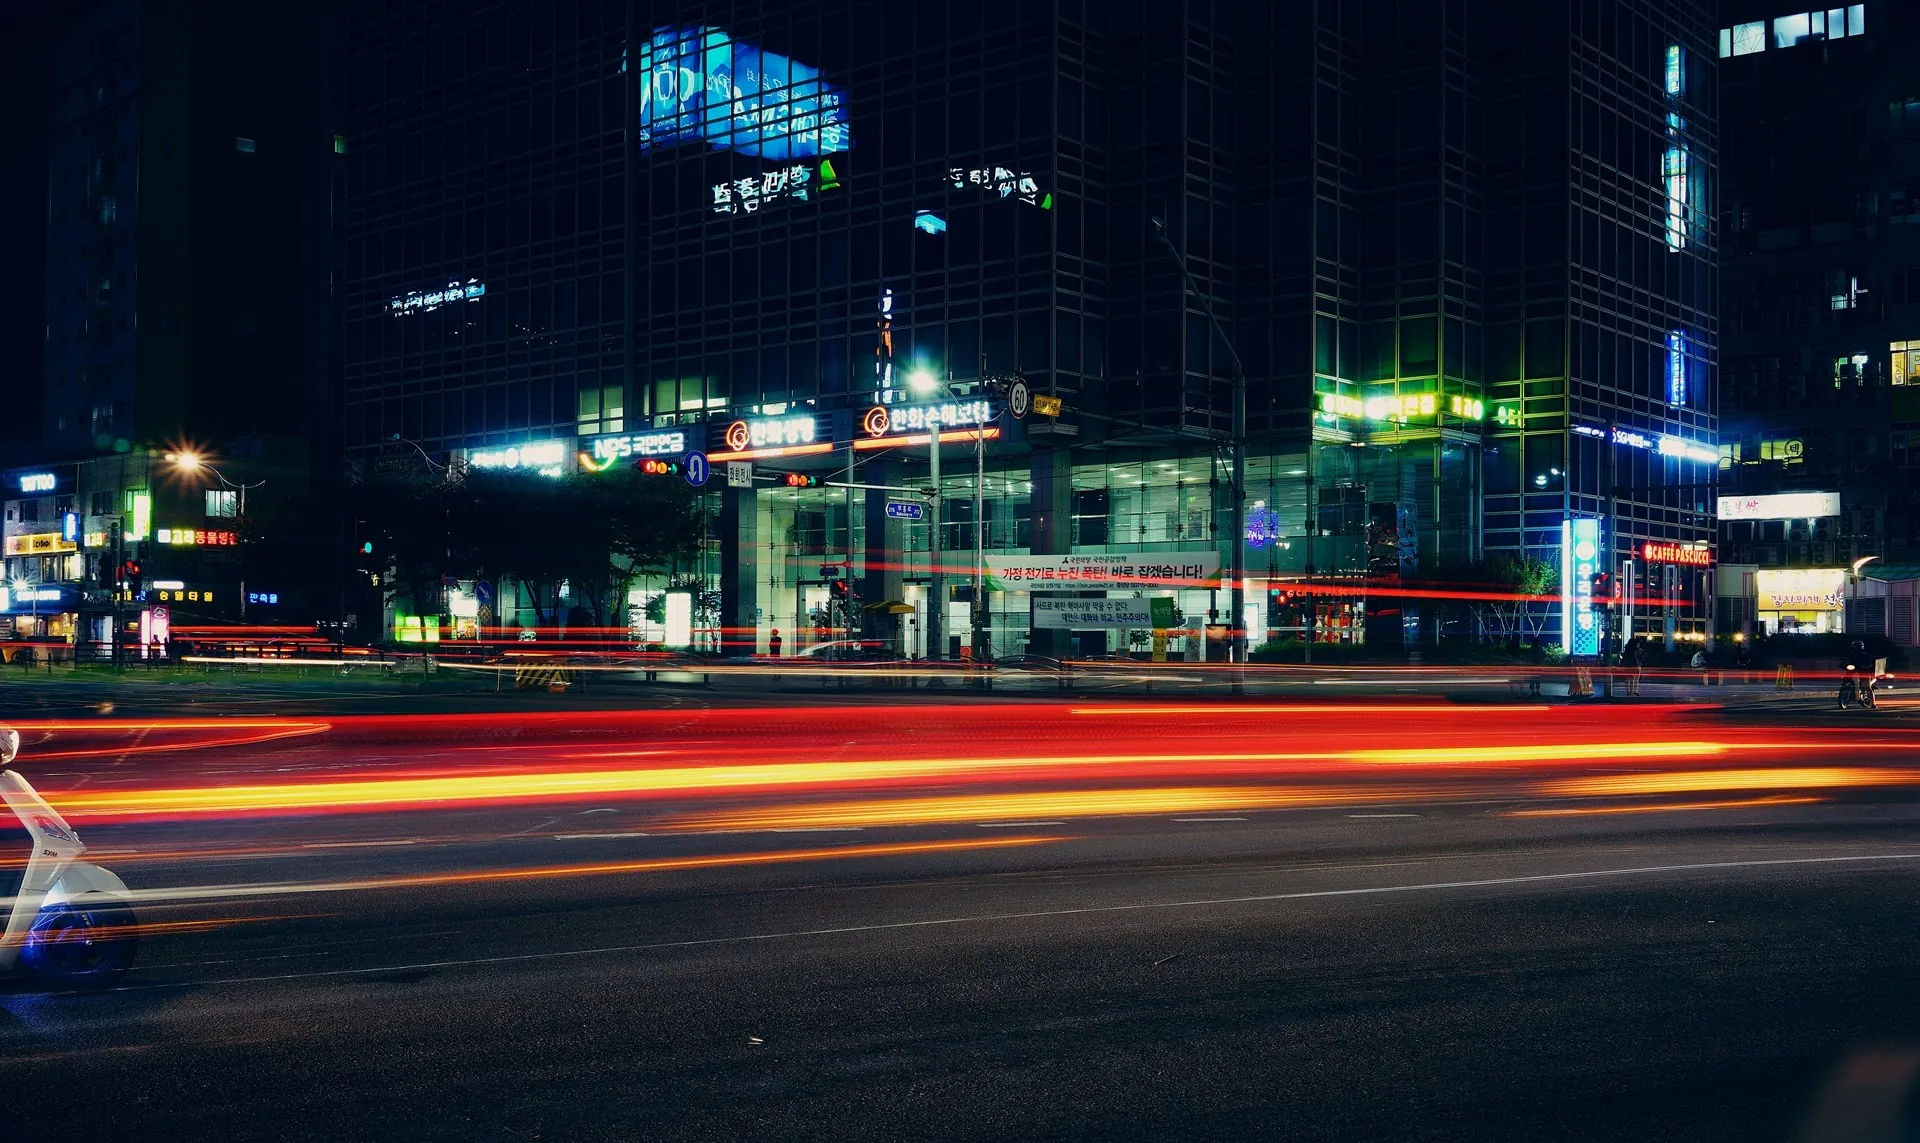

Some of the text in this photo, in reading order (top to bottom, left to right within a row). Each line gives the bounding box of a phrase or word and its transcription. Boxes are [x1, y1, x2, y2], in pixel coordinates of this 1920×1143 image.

[1014, 389, 1025, 411] 60
[1675, 548, 1709, 564] PASCUCCI
[1003, 564, 1203, 580] 가정 전기료 누진 폭탄! 바로 잡겠습니다!
[159, 590, 213, 602] 송월타월
[1577, 562, 1593, 631] 우리은행
[1771, 594, 1821, 607] 김치찌개
[1036, 601, 1053, 610] 사드로
[1054, 601, 1066, 611] 북한
[1106, 601, 1113, 609] 수
